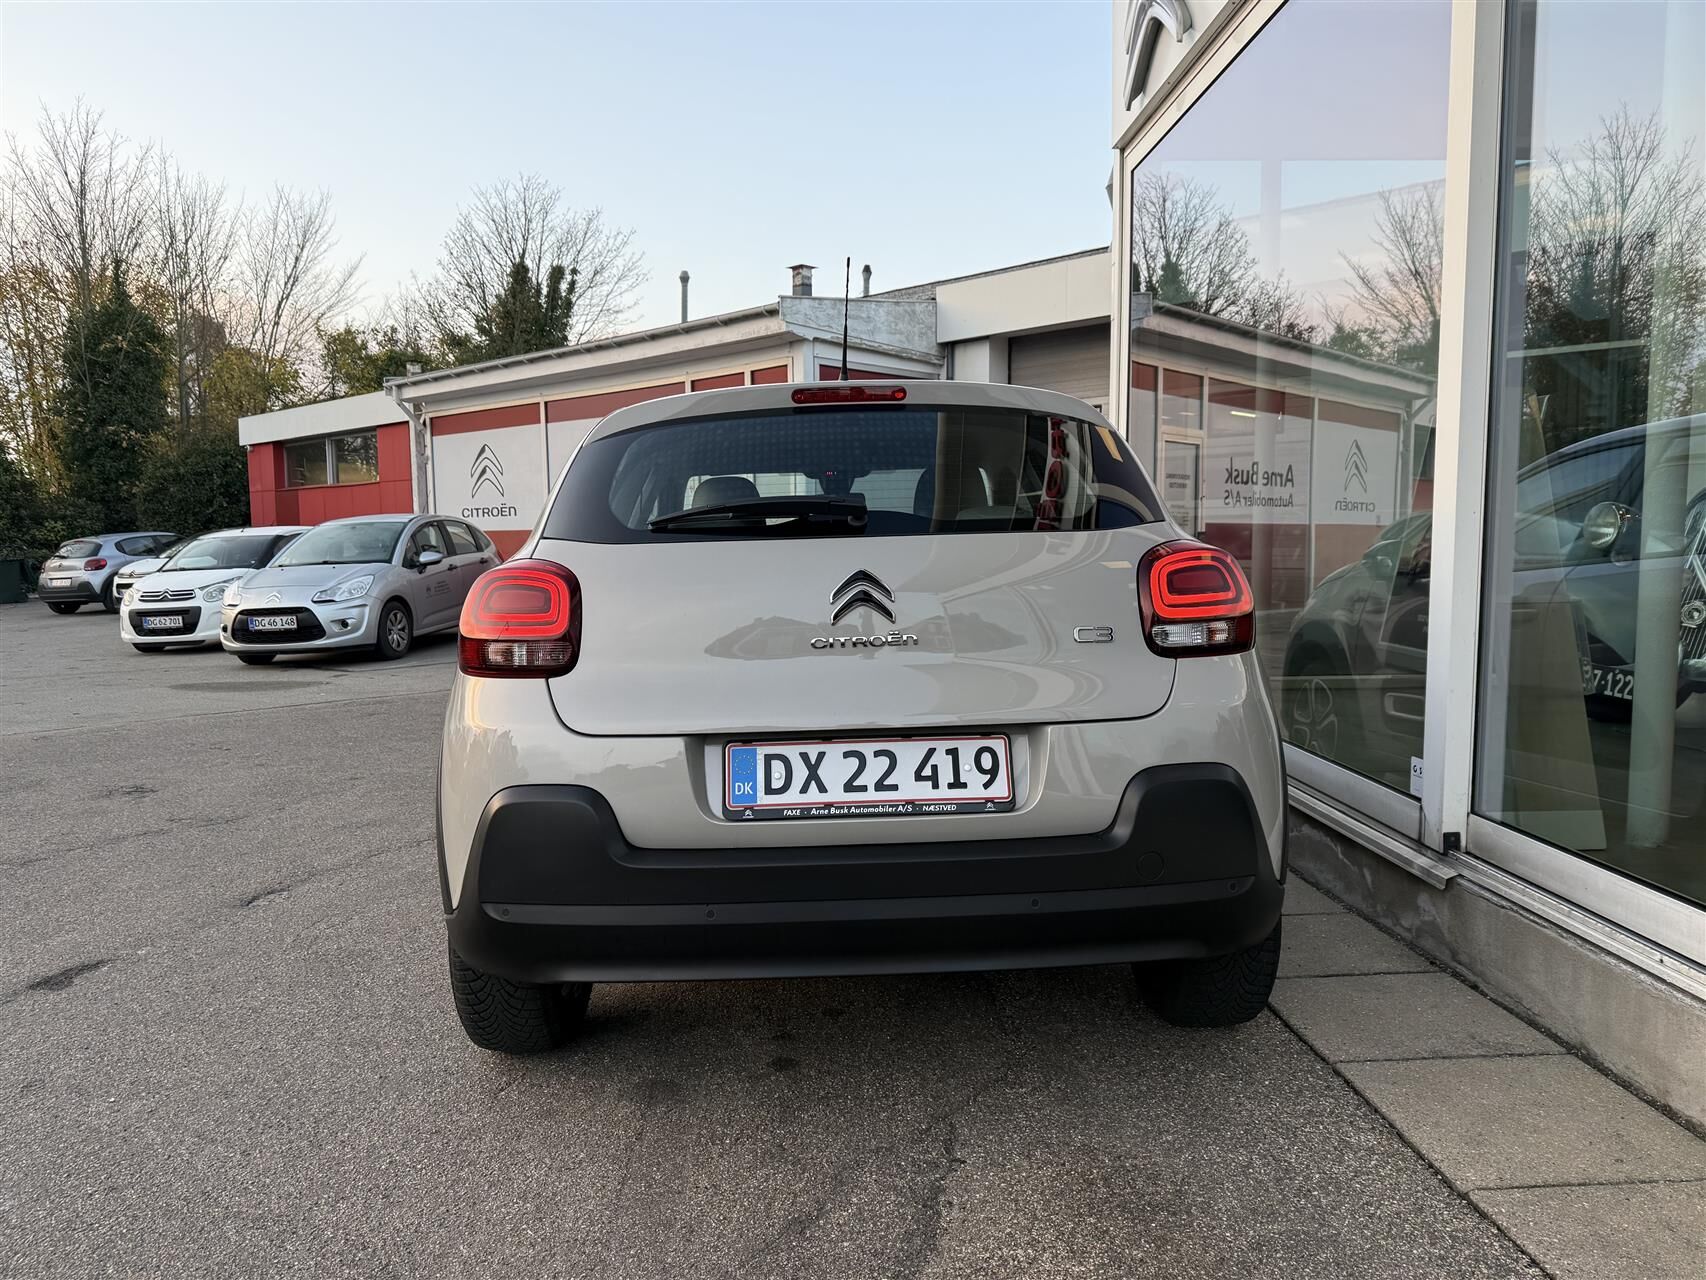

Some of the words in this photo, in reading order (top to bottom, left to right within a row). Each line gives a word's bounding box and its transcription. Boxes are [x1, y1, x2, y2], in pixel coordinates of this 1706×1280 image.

[462, 503, 517, 518] CITROËN
[255, 619, 266, 627] DG
[268, 619, 278, 627] 46
[280, 617, 295, 626] 148
[810, 631, 918, 650] CITROËN
[1073, 626, 1114, 643] C3
[763, 751, 828, 795] DX
[842, 750, 899, 793] 22
[914, 746, 1000, 790] 419
[735, 782, 753, 795] DK
[850, 805, 896, 814] Automobiler
[897, 805, 913, 813] A/S
